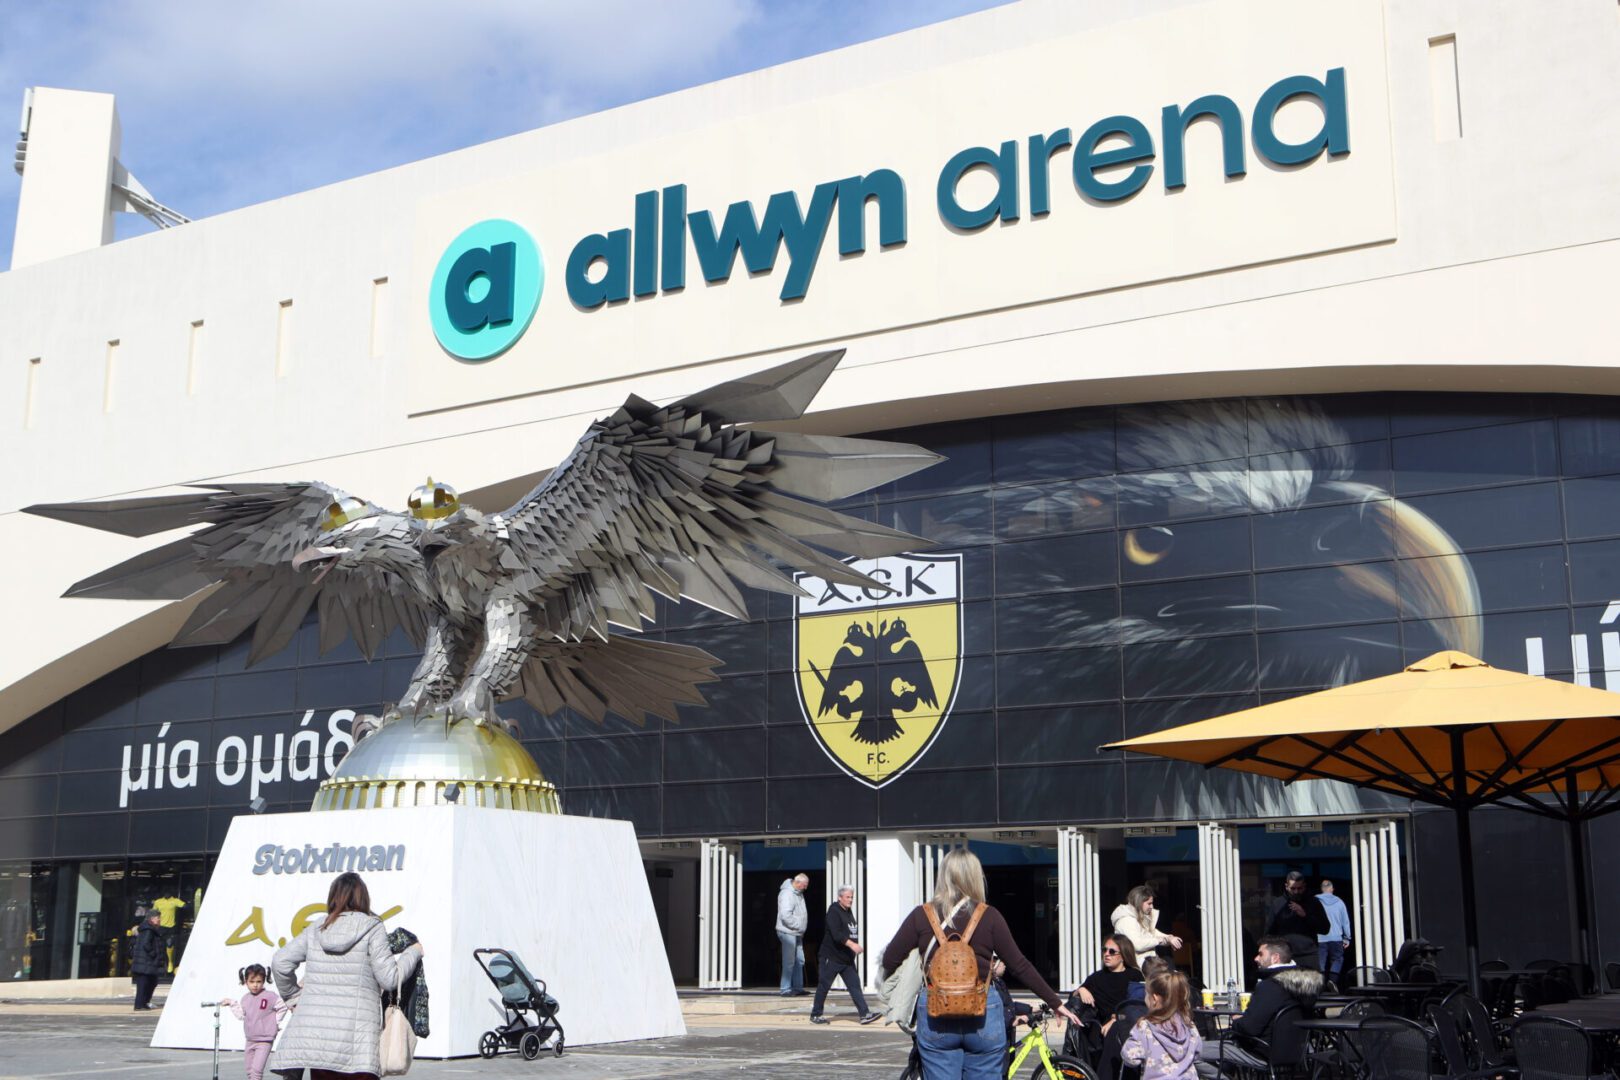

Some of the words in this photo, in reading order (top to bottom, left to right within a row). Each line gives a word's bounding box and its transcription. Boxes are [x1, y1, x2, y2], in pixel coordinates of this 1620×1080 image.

[566, 168, 907, 310] allwyn
[937, 67, 1351, 230] arena
[119, 722, 199, 807] μία
[216, 709, 356, 801] ομάδ
[867, 752, 890, 765] F.C.
[1309, 833, 1350, 849] allwy
[252, 842, 406, 875] Stoiximan
[260, 999, 267, 1010] D
